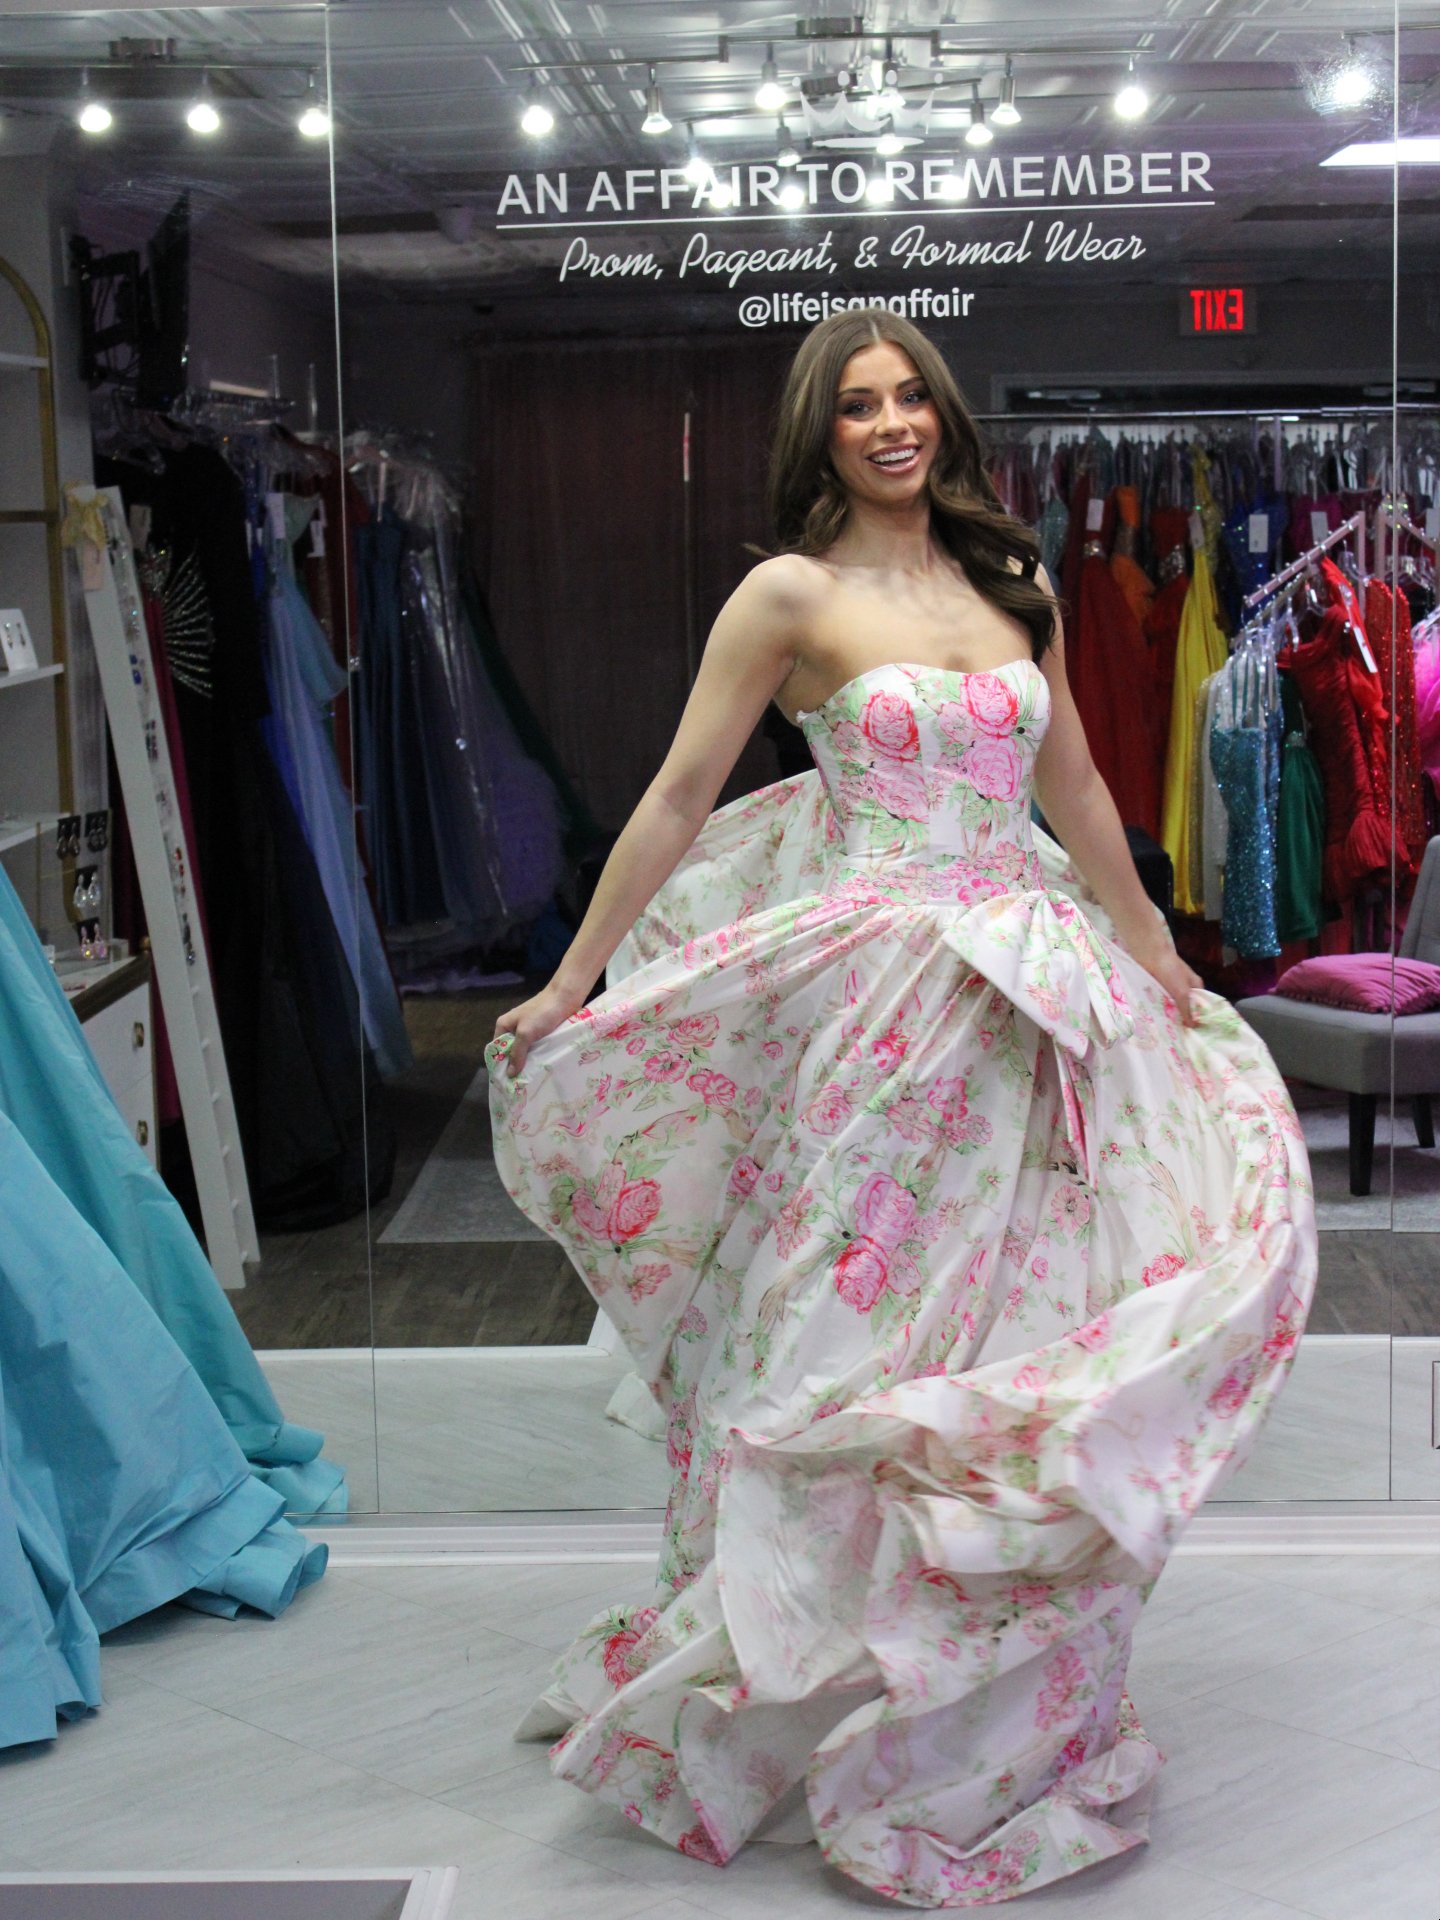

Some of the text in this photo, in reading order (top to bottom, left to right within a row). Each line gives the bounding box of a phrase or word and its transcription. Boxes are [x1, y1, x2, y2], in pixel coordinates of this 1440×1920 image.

[496, 151, 1214, 215] AN AFFAIR TO REMEMBER
[559, 220, 1147, 288] Prom, Pageant, & Formal Wear
